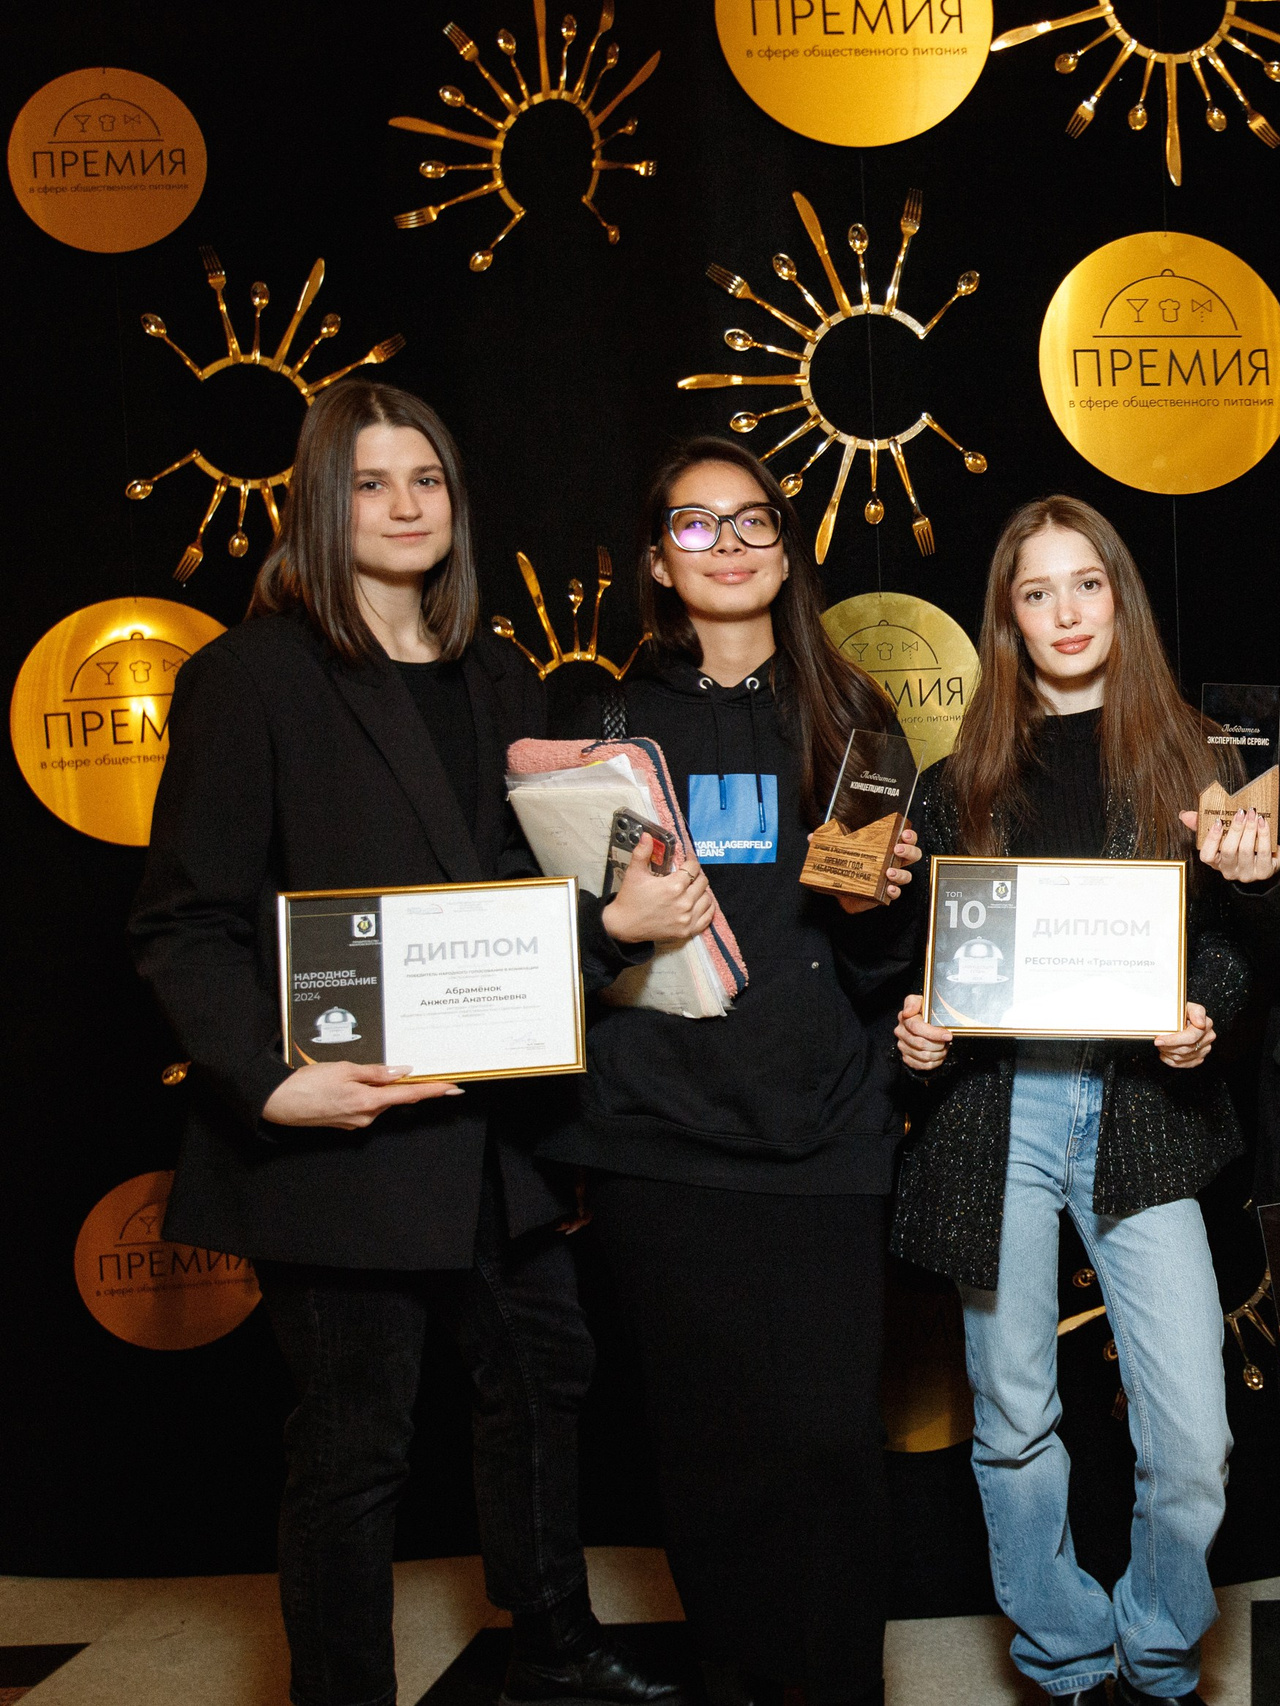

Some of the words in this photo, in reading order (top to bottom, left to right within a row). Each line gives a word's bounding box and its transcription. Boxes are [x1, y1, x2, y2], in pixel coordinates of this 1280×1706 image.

[751, 0, 963, 36] ПРЕМИЯ
[746, 49, 754, 58] в
[757, 46, 800, 62] сфере
[803, 45, 909, 59] общественного
[912, 46, 968, 57] питания
[32, 148, 187, 179] ПРЕМИЯ
[37, 184, 68, 195] сфере
[1072, 348, 1271, 387] ПРЕМИЯ
[1068, 399, 1076, 408] в
[1079, 396, 1119, 411] сфере
[1122, 395, 1220, 409] общественного
[1223, 396, 1275, 408] питания
[884, 676, 964, 708] МИЯ
[926, 714, 963, 723] питани
[44, 708, 169, 750] ПРЕМ
[1207, 735, 1247, 745] ЭКСПЕРТНЫЙ
[1247, 737, 1270, 746] СЕРВИС
[40, 761, 47, 769] в
[51, 757, 91, 772] сфере
[94, 754, 167, 766] обществен
[884, 786, 900, 797] ГОДА
[694, 841, 720, 849] KARL
[720, 840, 773, 849] LAGERFELD
[849, 860, 863, 870] ГОДА
[945, 900, 987, 929] 10
[1032, 918, 1151, 938] ДИПЛОМ
[403, 936, 539, 966] ДИПЛОМ
[1024, 956, 1084, 966] РЕСТОРАН
[1087, 957, 1156, 968] «Траттория»
[294, 969, 357, 982] НАРОДНОЕ
[294, 976, 378, 990] ГОЛОСОВАНИЕ
[445, 985, 502, 995] Абрамёнок
[294, 992, 321, 1002] 2024
[420, 998, 460, 1006] Анжела
[462, 993, 527, 1004] Анатольевна
